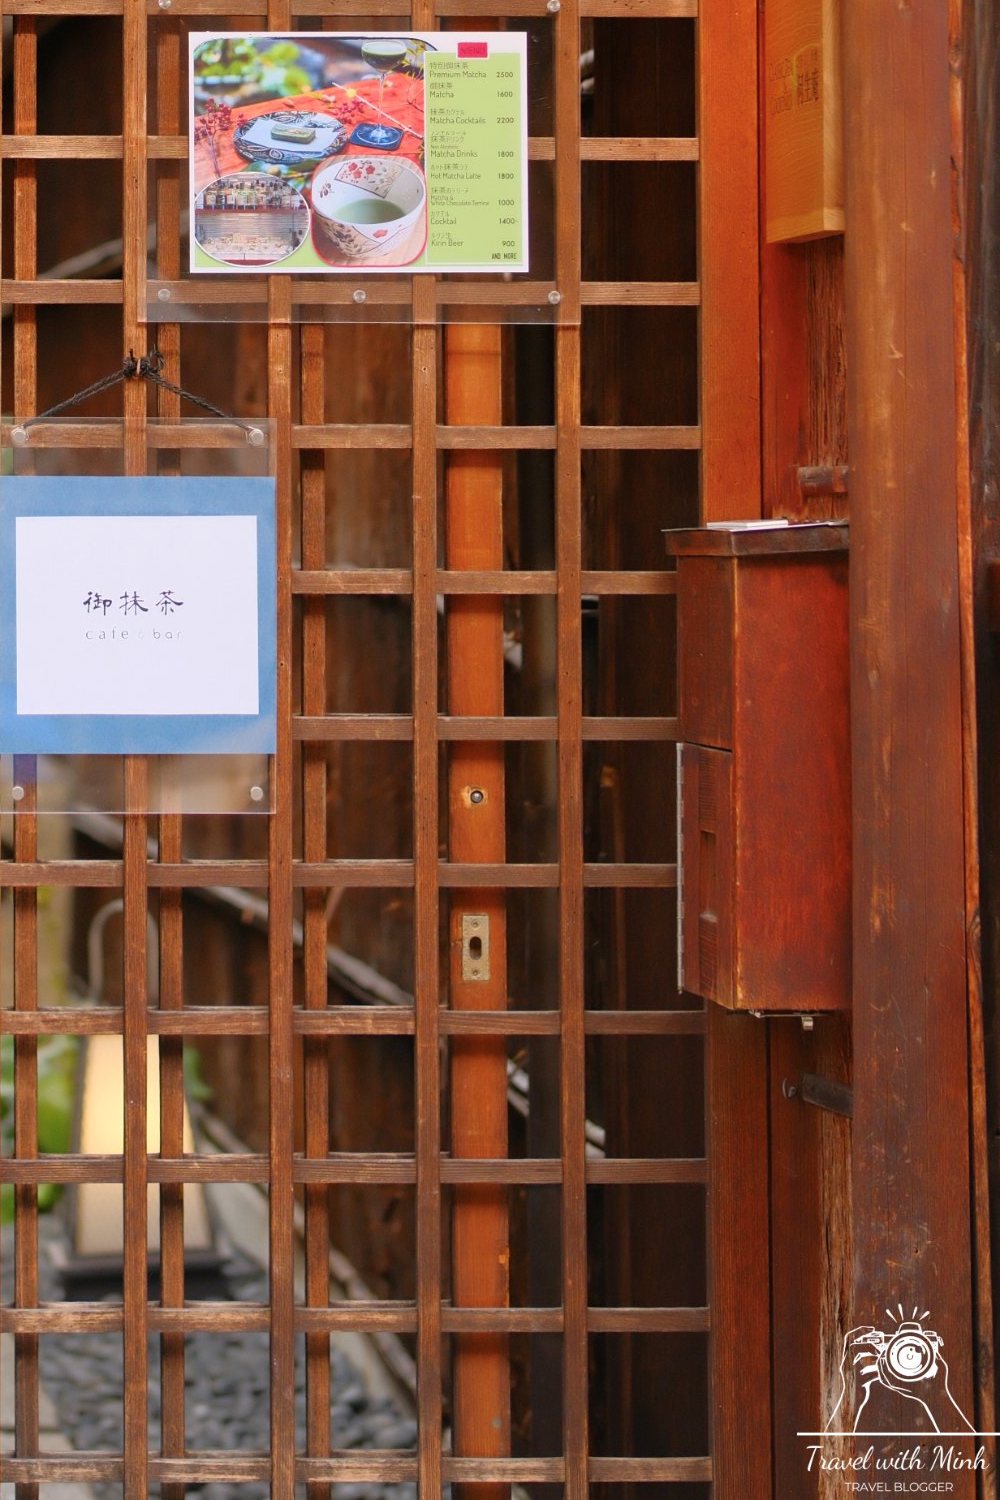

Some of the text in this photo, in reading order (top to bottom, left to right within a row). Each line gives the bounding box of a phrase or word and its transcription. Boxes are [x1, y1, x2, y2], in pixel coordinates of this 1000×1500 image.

[430, 217, 457, 225] Cocktail
[430, 239, 447, 247] Kirin
[448, 239, 464, 247] Beer
[83, 590, 184, 616] 御抹茶
[85, 627, 129, 640] cafe
[152, 628, 182, 640] bar
